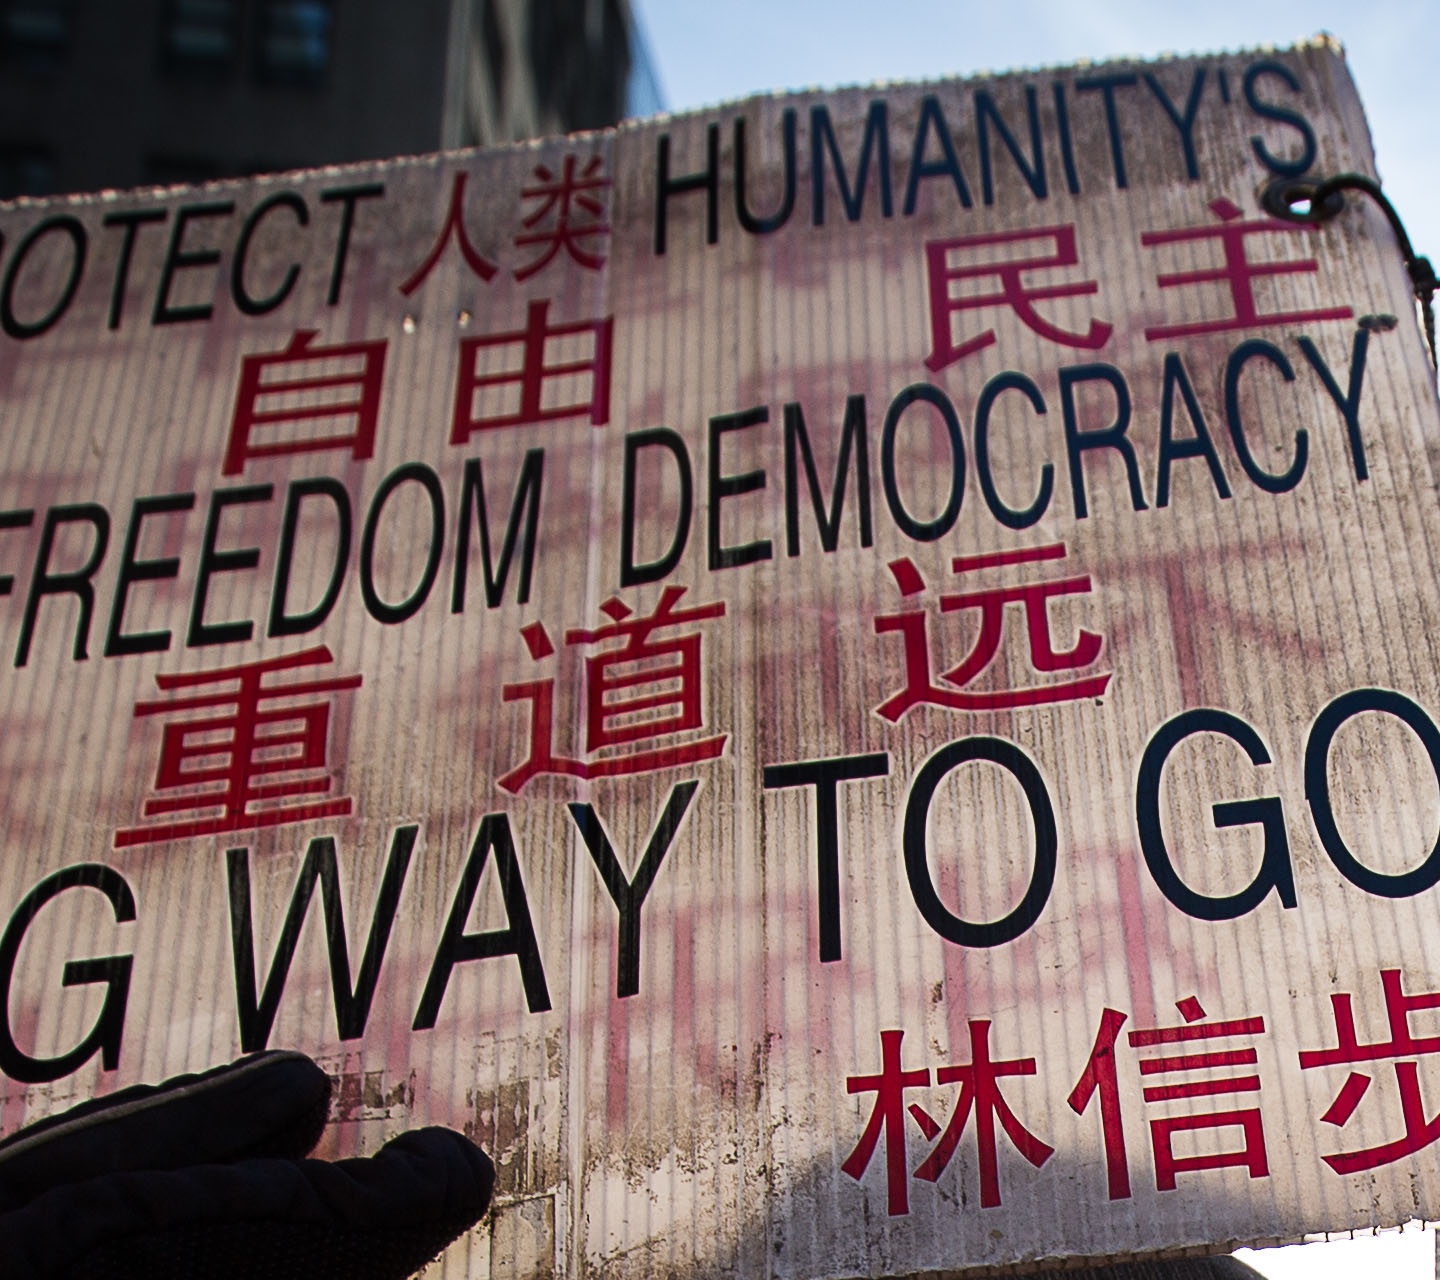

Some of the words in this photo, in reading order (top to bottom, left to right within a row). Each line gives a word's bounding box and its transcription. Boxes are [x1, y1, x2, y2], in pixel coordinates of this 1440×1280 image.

[398, 153, 612, 297] 人类
[652, 60, 1317, 257] HUMANITY'S
[220, 299, 614, 476] 自由
[922, 200, 1354, 372] 民主
[619, 319, 1378, 587] DEMOCRACY
[225, 780, 700, 1056] WAY
[763, 733, 1058, 963] TO
